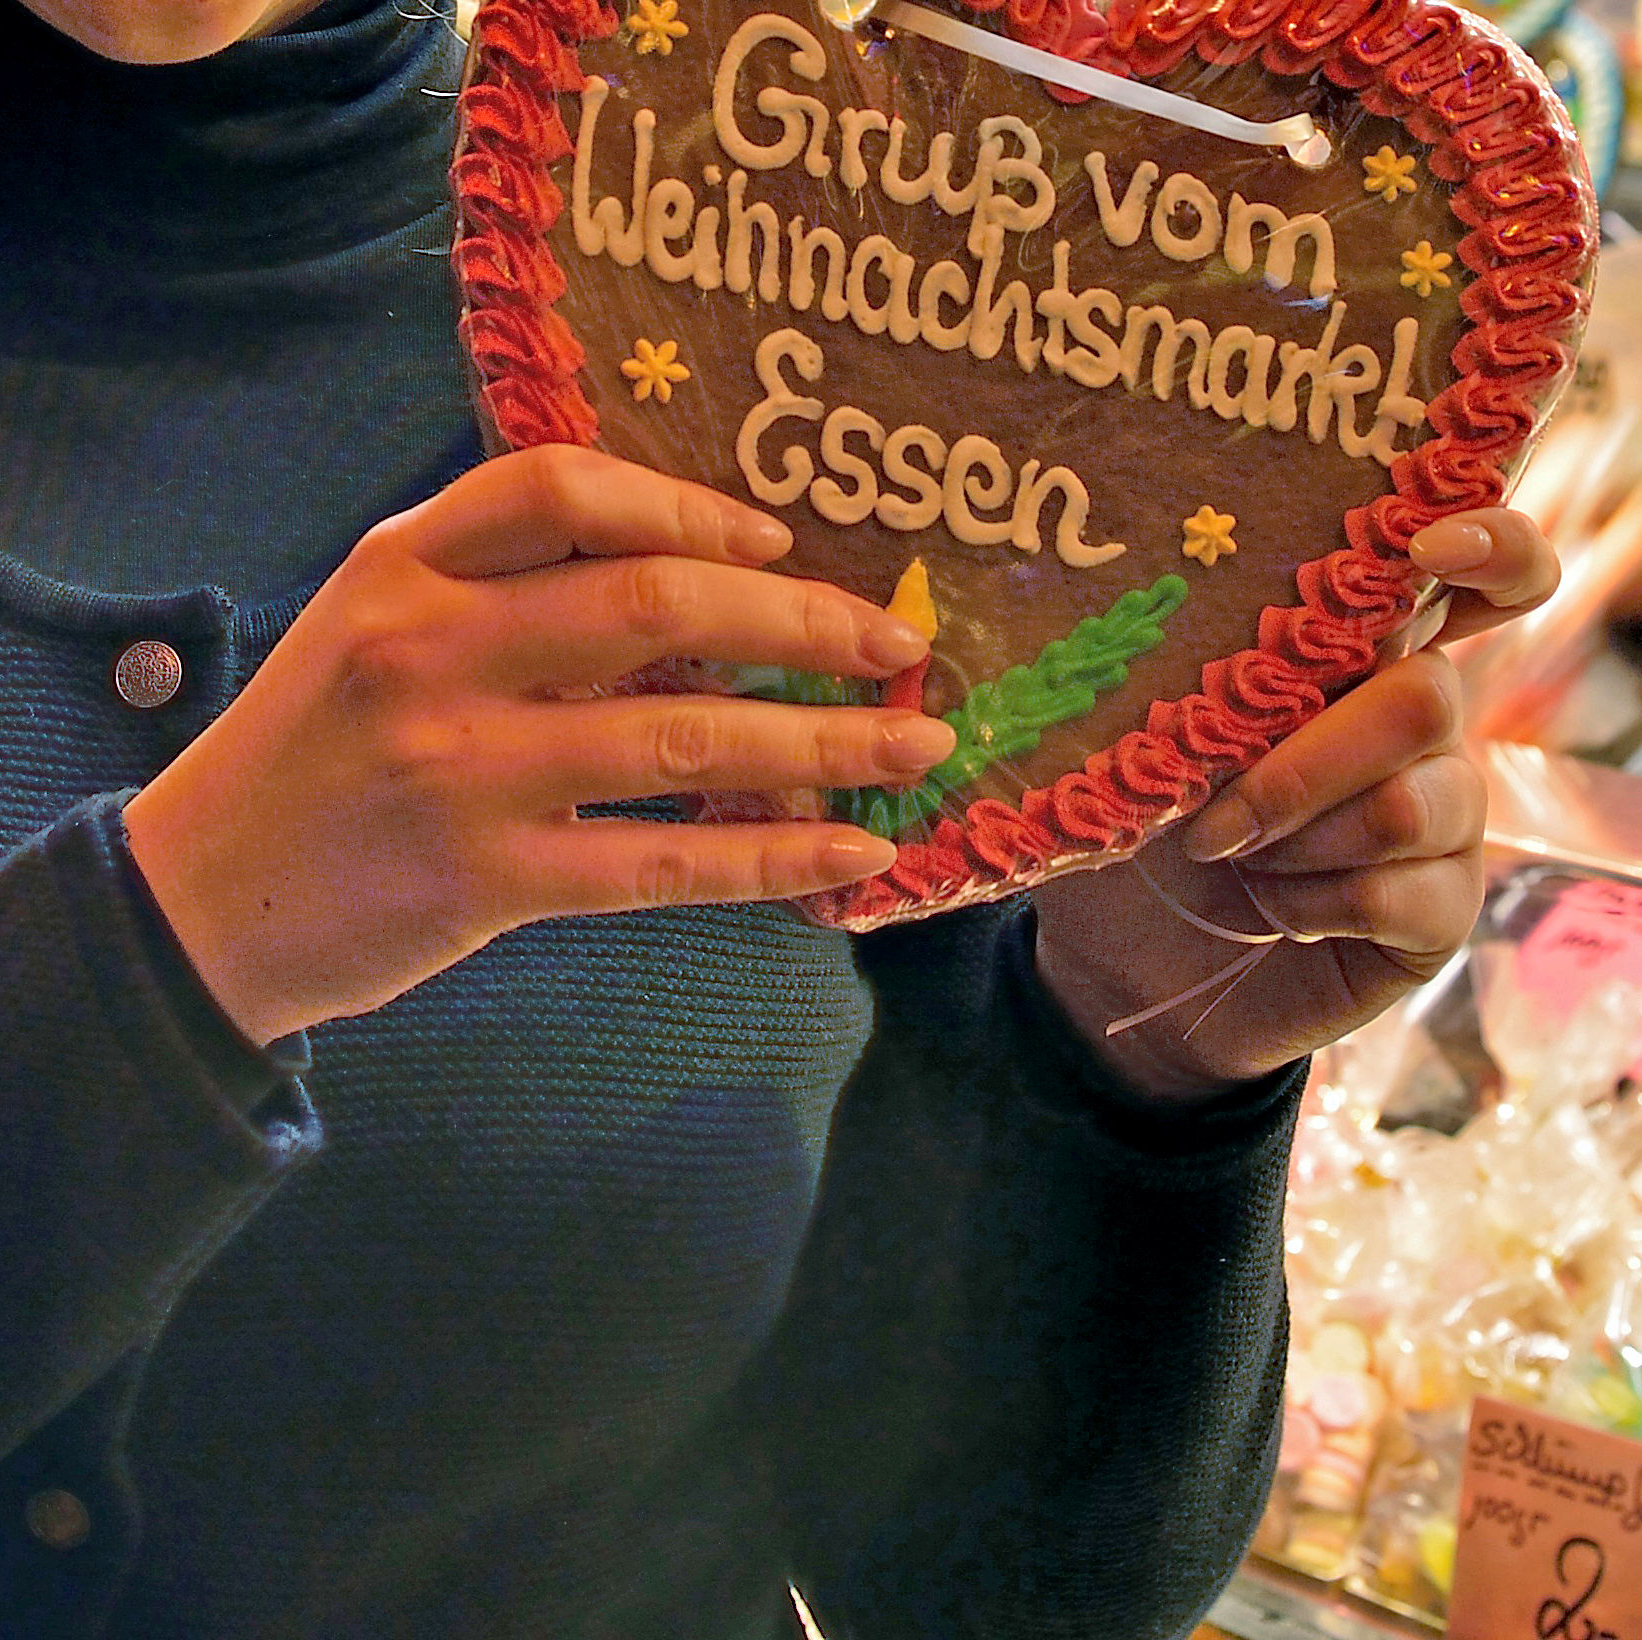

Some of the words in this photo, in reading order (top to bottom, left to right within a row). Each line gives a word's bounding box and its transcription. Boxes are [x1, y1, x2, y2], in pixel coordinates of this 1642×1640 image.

[571, 73, 1427, 466] Weihnachtsmarkt
[711, 12, 1057, 259] Gruß
[1083, 148, 1338, 299] vom
[735, 328, 1128, 569] Essen
